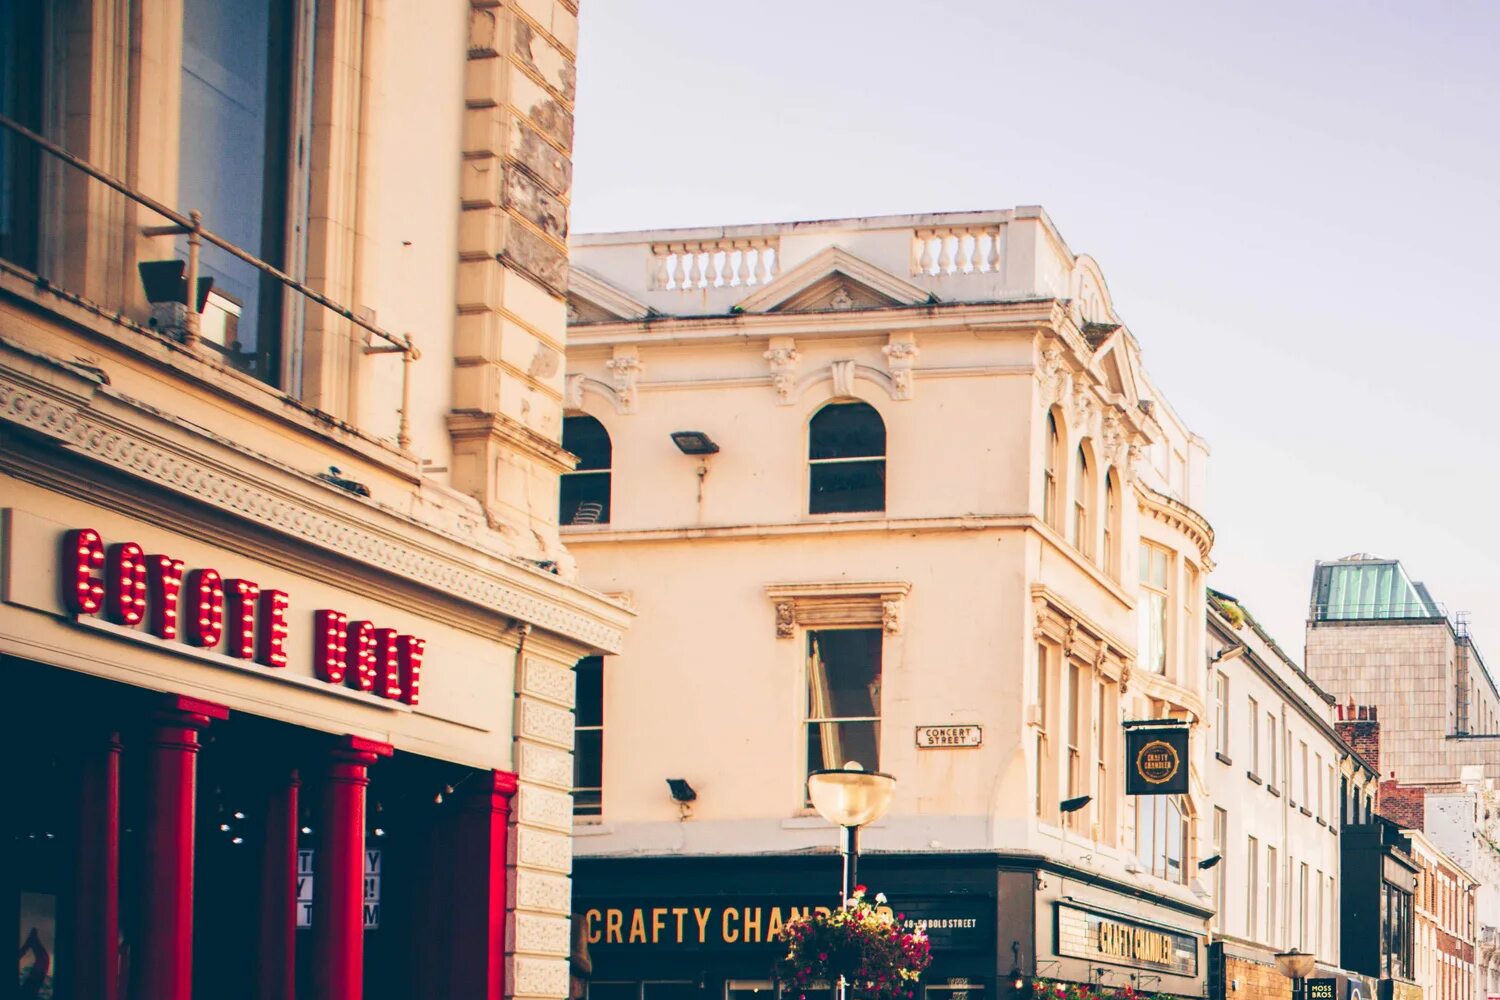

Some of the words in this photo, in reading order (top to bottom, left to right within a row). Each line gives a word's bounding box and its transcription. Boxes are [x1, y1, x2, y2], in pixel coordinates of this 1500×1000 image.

[64, 528, 288, 667] COYOTE
[315, 609, 426, 706] UGLY
[926, 728, 971, 737] CONCERT
[928, 736, 966, 744] STREET
[1147, 754, 1168, 762] CRAFTY
[586, 907, 712, 944] CRAFTY
[928, 919, 947, 928] BOLD
[948, 919, 976, 928] STREET
[1098, 920, 1134, 958] CRAFTY
[1133, 928, 1172, 966] CHANDLER
